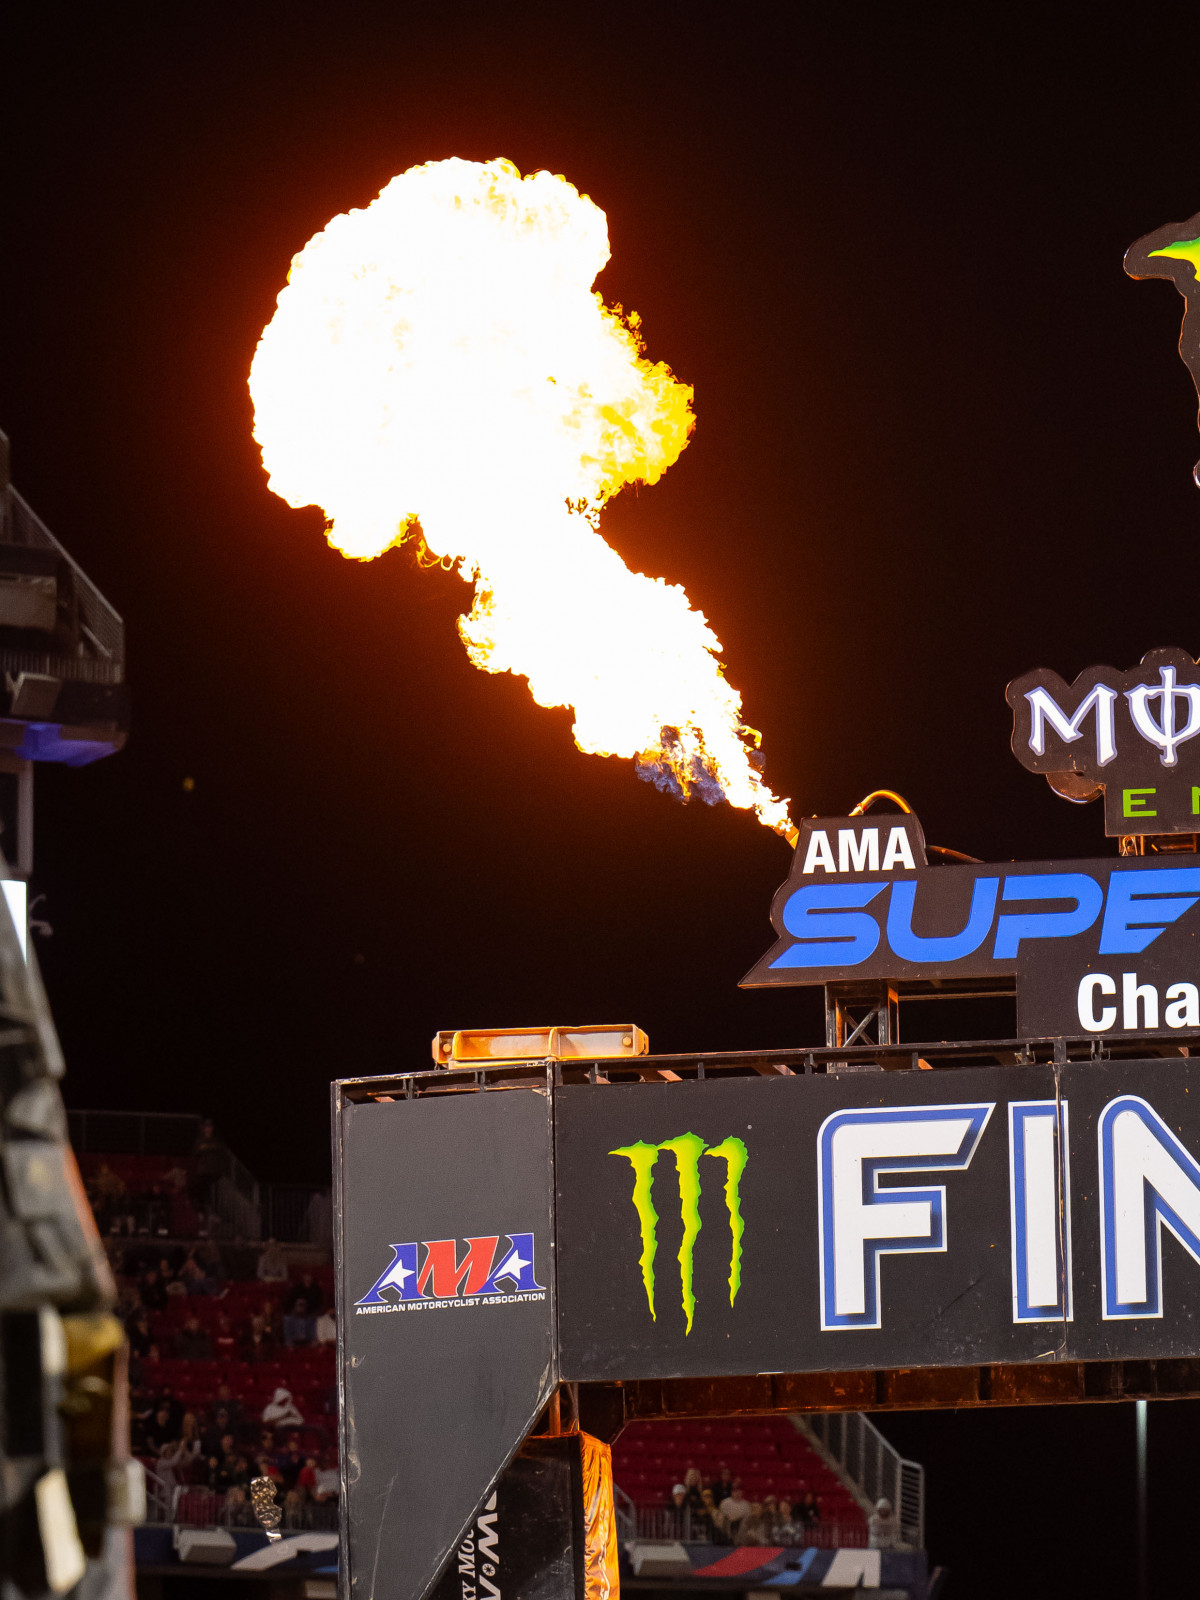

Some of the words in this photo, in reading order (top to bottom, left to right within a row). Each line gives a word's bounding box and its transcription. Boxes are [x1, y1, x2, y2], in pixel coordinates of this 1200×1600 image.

[802, 827, 915, 874] AMA
[353, 1232, 547, 1306] AMA
[355, 1301, 406, 1315] AMERICAN
[407, 1297, 480, 1311] MOTORCYCLIST
[482, 1292, 546, 1306] ASSOCIATION
